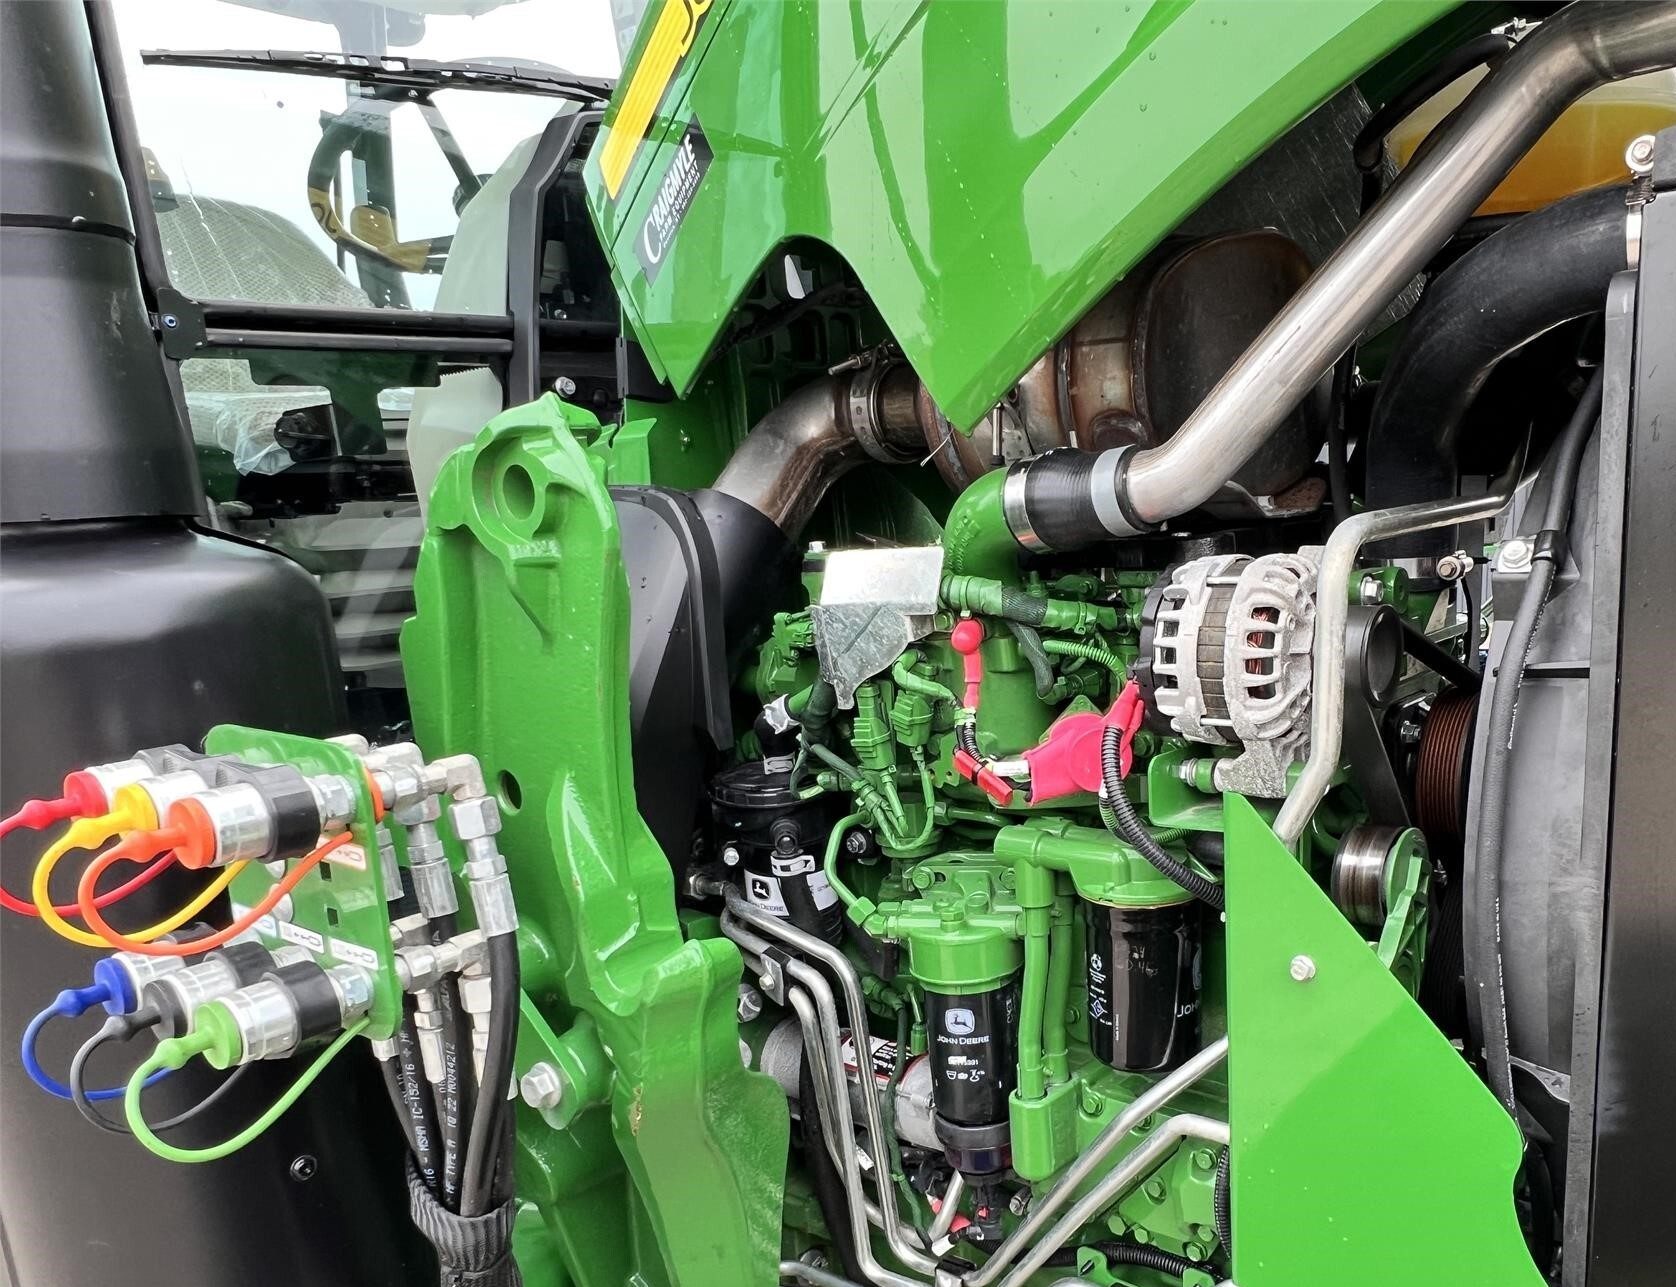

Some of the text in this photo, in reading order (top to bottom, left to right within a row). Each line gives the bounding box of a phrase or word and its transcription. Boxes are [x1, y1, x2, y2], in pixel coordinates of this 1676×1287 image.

[643, 133, 696, 264] CRAIGMYLE
[660, 215, 672, 242] FARM
[672, 159, 698, 217] EQUIPMENT
[937, 1034, 990, 1045] JOHN DEERE
